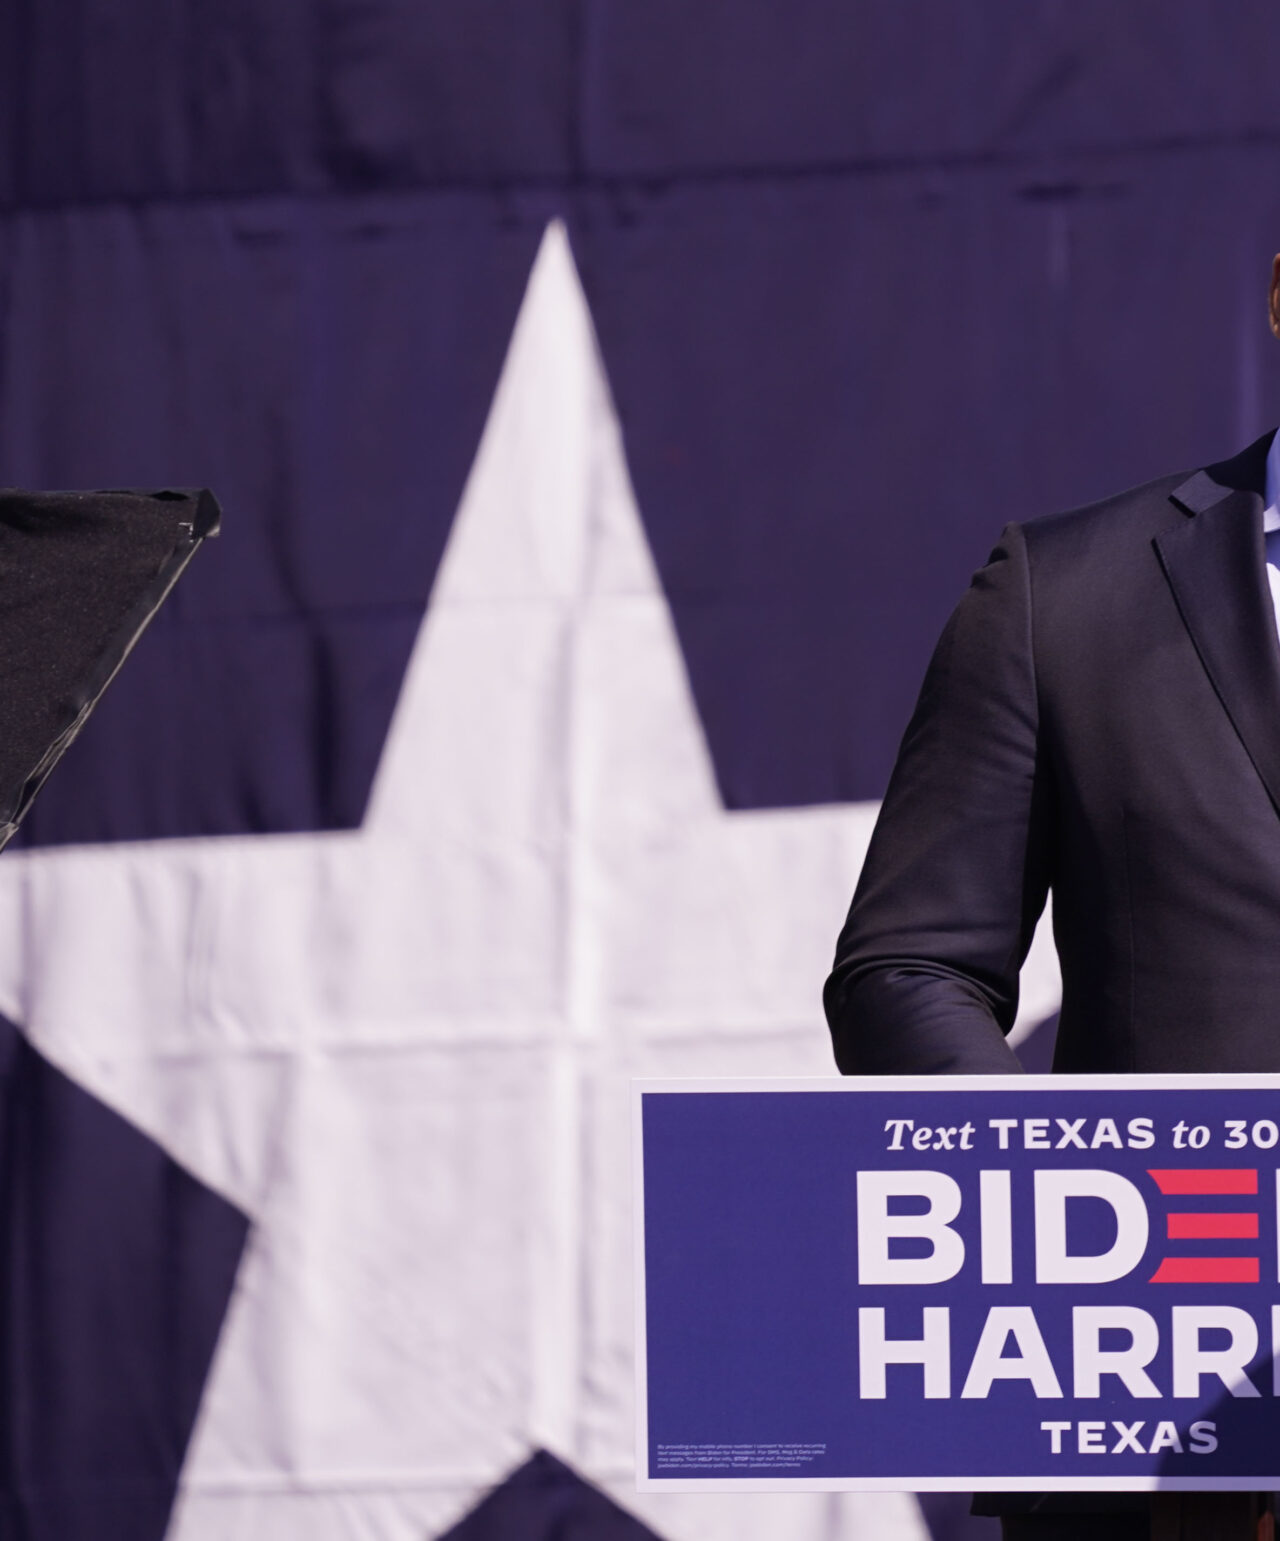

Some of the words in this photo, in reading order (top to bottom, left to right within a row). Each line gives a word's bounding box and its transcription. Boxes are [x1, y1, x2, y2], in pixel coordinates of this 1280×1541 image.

[884, 1119, 976, 1151] Text
[988, 1117, 1156, 1150] TEXAS
[1171, 1119, 1212, 1150] to
[1040, 1420, 1218, 1455] TEXAS
